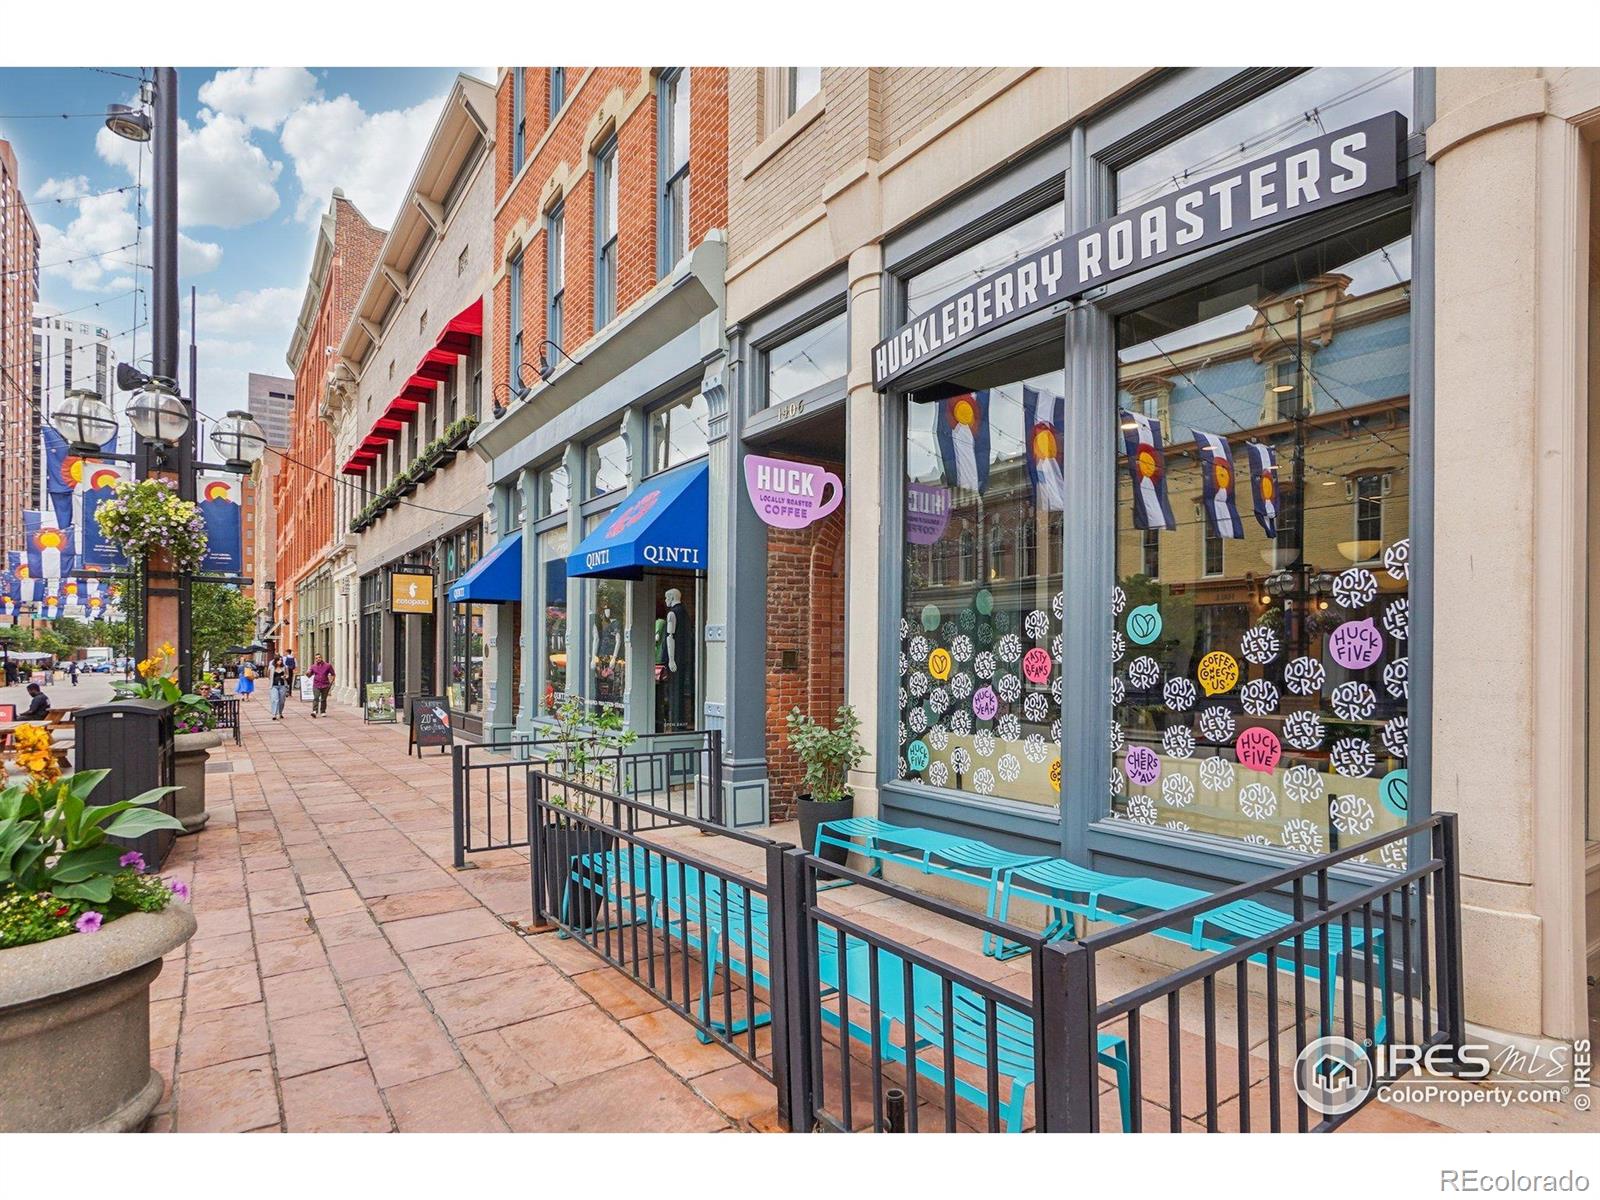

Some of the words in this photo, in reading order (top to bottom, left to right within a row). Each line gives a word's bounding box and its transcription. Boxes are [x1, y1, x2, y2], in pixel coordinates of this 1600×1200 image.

[876, 249, 1063, 382] HUCKLEBERRY
[1078, 131, 1367, 283] ROASTERS
[757, 465, 814, 497] HUCK
[760, 494, 785, 503] LOCALLY
[787, 498, 812, 508] ROASTED
[765, 505, 807, 518] COFFEE
[586, 550, 610, 569] QINTI
[643, 546, 699, 564] QINTI
[1332, 568, 1378, 596] ROAST
[1336, 589, 1376, 608] ERS
[1241, 638, 1280, 654] LEBE
[1243, 627, 1275, 647] HUCK
[1335, 627, 1378, 649] HUCK
[1025, 651, 1047, 664] TASTY
[1203, 654, 1235, 670] COFFEE
[1246, 651, 1277, 664] RRY
[1026, 665, 1048, 677] BEANS
[1129, 656, 1159, 678] ROAST
[1284, 656, 1326, 683] ROAST
[1131, 673, 1158, 689] ERS
[1164, 677, 1196, 700] ROAST
[1212, 680, 1226, 690] US
[1288, 677, 1324, 695] ERS
[975, 691, 994, 704] HUCK
[1240, 679, 1278, 704] ROAST
[1332, 681, 1376, 709] ROAST
[976, 703, 994, 715] YEAH
[1166, 695, 1195, 711] ERS
[1244, 698, 1277, 716] ERS
[1335, 702, 1375, 722] ERS
[1200, 717, 1235, 733] LEBE
[1202, 706, 1231, 726] HUCK
[1286, 711, 1320, 732] HUCK
[1164, 725, 1192, 744] HUCK
[1204, 729, 1233, 742] RRY
[1283, 723, 1325, 740] LEBE
[1162, 735, 1196, 750] LEBE
[1242, 733, 1278, 754] HUCK
[1288, 736, 1322, 750] RRY
[1333, 738, 1370, 760] HUCK
[910, 745, 928, 759] HUCK
[1128, 749, 1158, 771] CHEERS
[1166, 747, 1194, 759] RRY
[1330, 750, 1376, 768] LEBE
[1130, 770, 1156, 784] Y'ALL
[1200, 756, 1234, 780] ROAST
[1335, 764, 1373, 778] RRY
[1162, 773, 1194, 796] ROAST
[1203, 774, 1233, 792] ERS
[1284, 765, 1324, 791] ROAST
[1165, 791, 1194, 807] ERS
[1240, 783, 1277, 808] ROAST
[1287, 785, 1322, 804] ERS
[1129, 795, 1154, 813] HUCK
[1243, 802, 1276, 820] ERS
[1330, 795, 1374, 822] ROAST
[1284, 819, 1318, 840] HUCK
[1334, 816, 1373, 834] ERS
